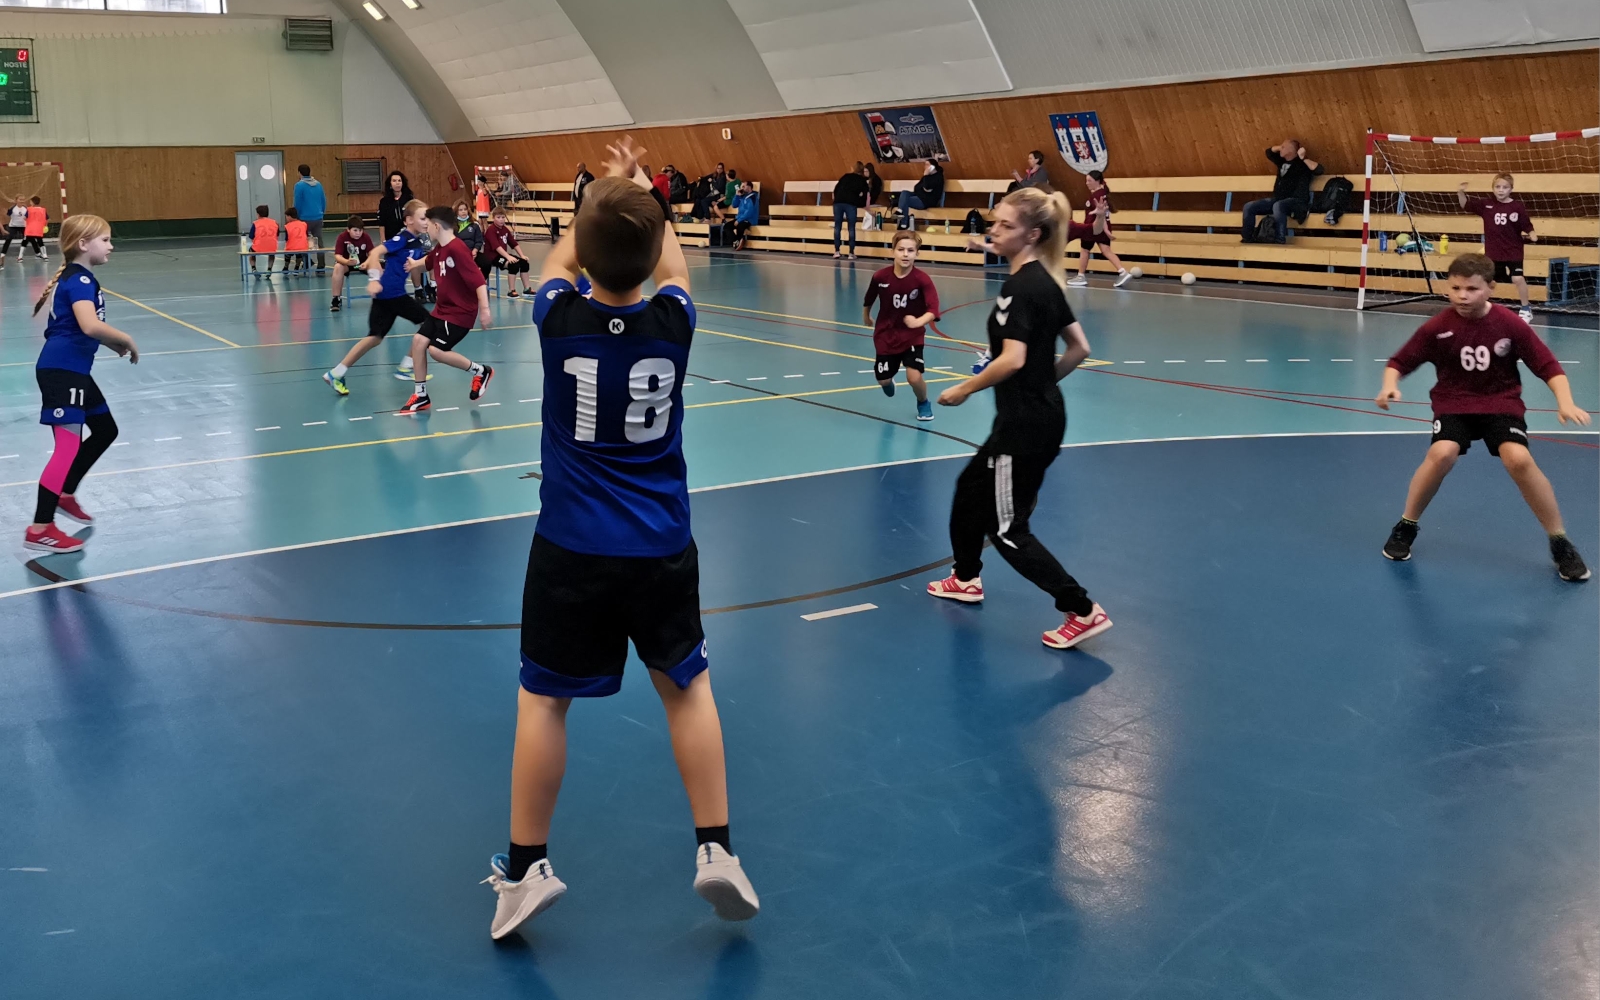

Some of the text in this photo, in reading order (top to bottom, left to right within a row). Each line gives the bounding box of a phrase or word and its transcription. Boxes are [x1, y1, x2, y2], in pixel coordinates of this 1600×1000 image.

[899, 124, 935, 135] ATMOS
[1494, 212, 1507, 225] 65
[893, 294, 907, 308] 64
[1460, 345, 1490, 371] 69
[878, 361, 889, 373] 64
[69, 387, 84, 406] 11
[563, 356, 676, 444] 18
